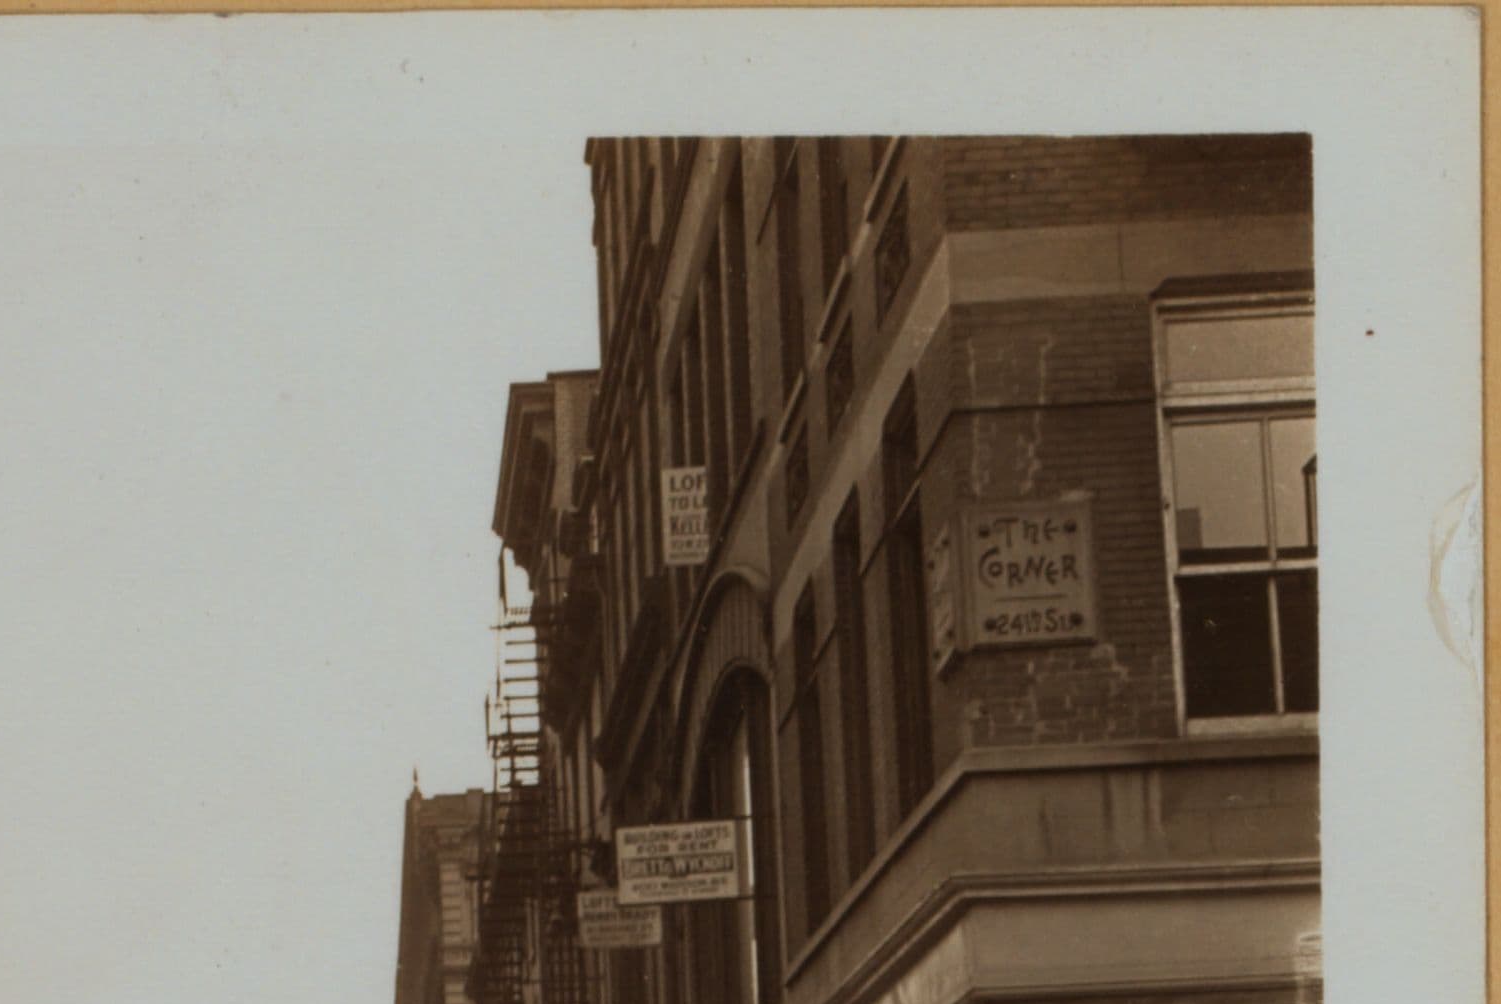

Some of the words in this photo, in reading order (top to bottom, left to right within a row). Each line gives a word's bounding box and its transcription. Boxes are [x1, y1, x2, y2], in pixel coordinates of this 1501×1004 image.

[979, 547, 1079, 588] CORNER
[637, 843, 669, 855] FOR
[678, 839, 717, 851] RENT
